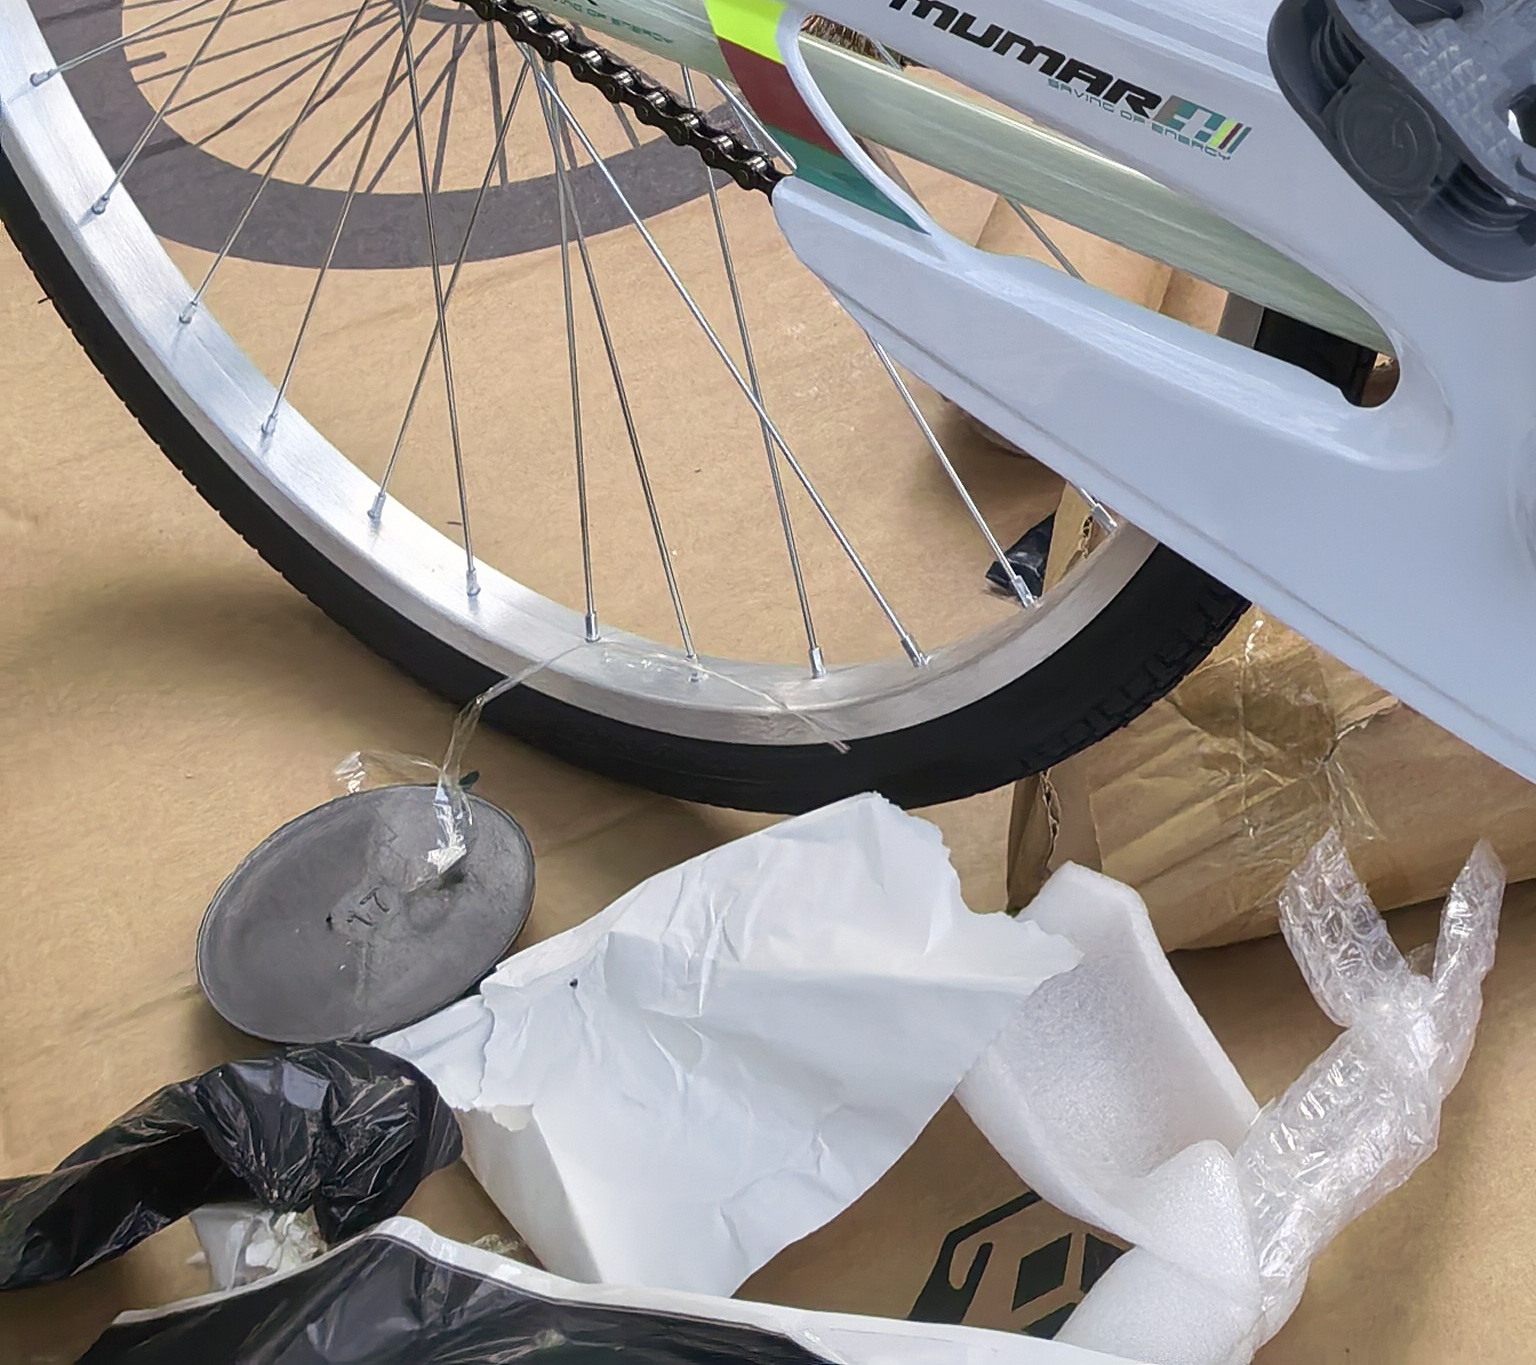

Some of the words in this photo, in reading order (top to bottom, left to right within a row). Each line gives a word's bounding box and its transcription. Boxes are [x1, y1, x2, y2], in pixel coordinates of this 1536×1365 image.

[1047, 77, 1115, 114] SAVING
[1120, 109, 1147, 126] OF
[1151, 122, 1231, 161] ENERGY
